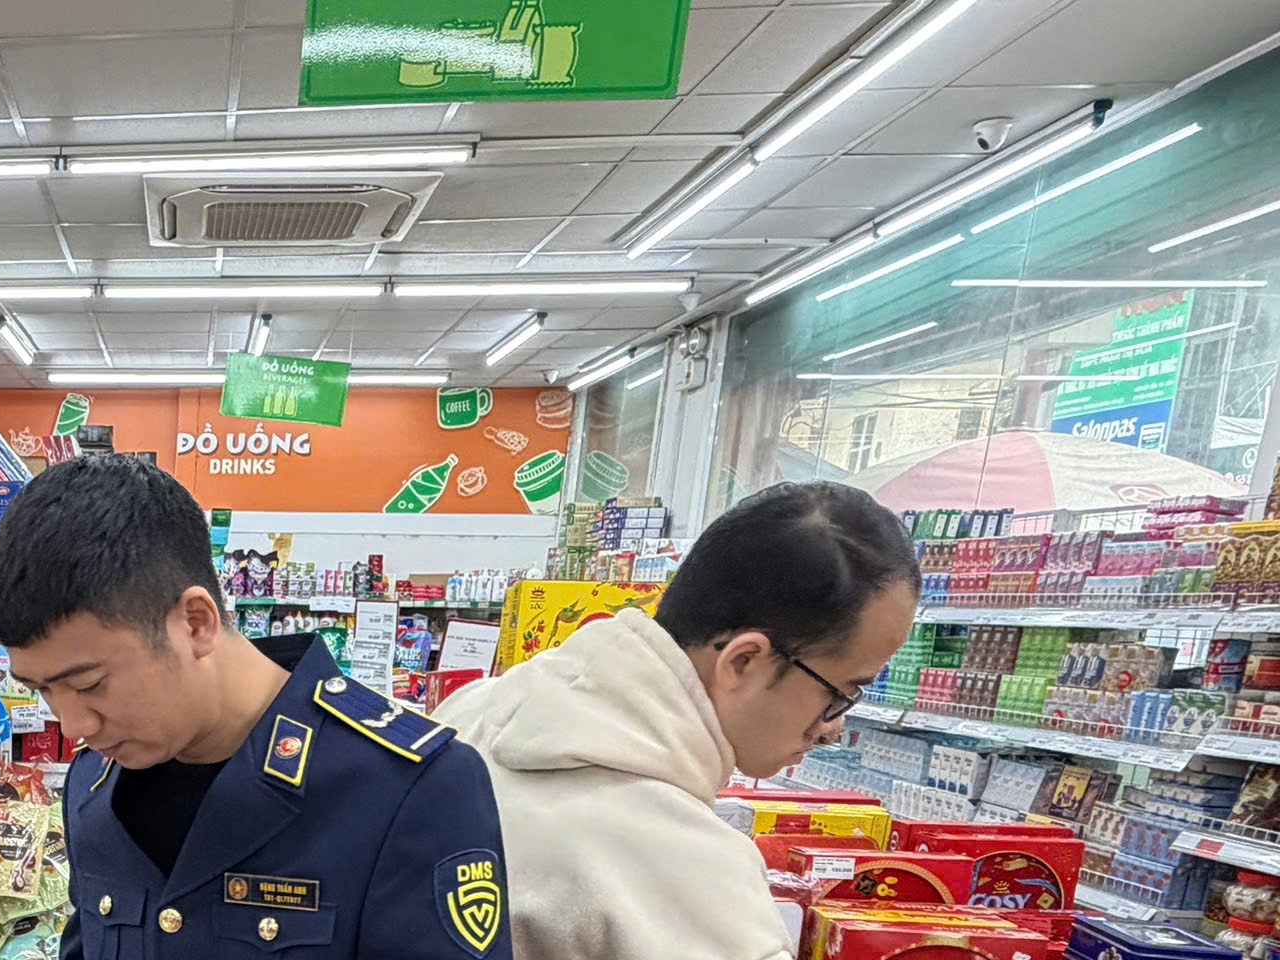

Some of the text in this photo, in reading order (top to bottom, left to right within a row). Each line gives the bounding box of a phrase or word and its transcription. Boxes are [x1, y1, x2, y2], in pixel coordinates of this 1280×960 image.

[177, 424, 311, 456] ĐỒ UỐNG
[209, 458, 276, 475] DRINKS
[457, 861, 493, 883] DMS
